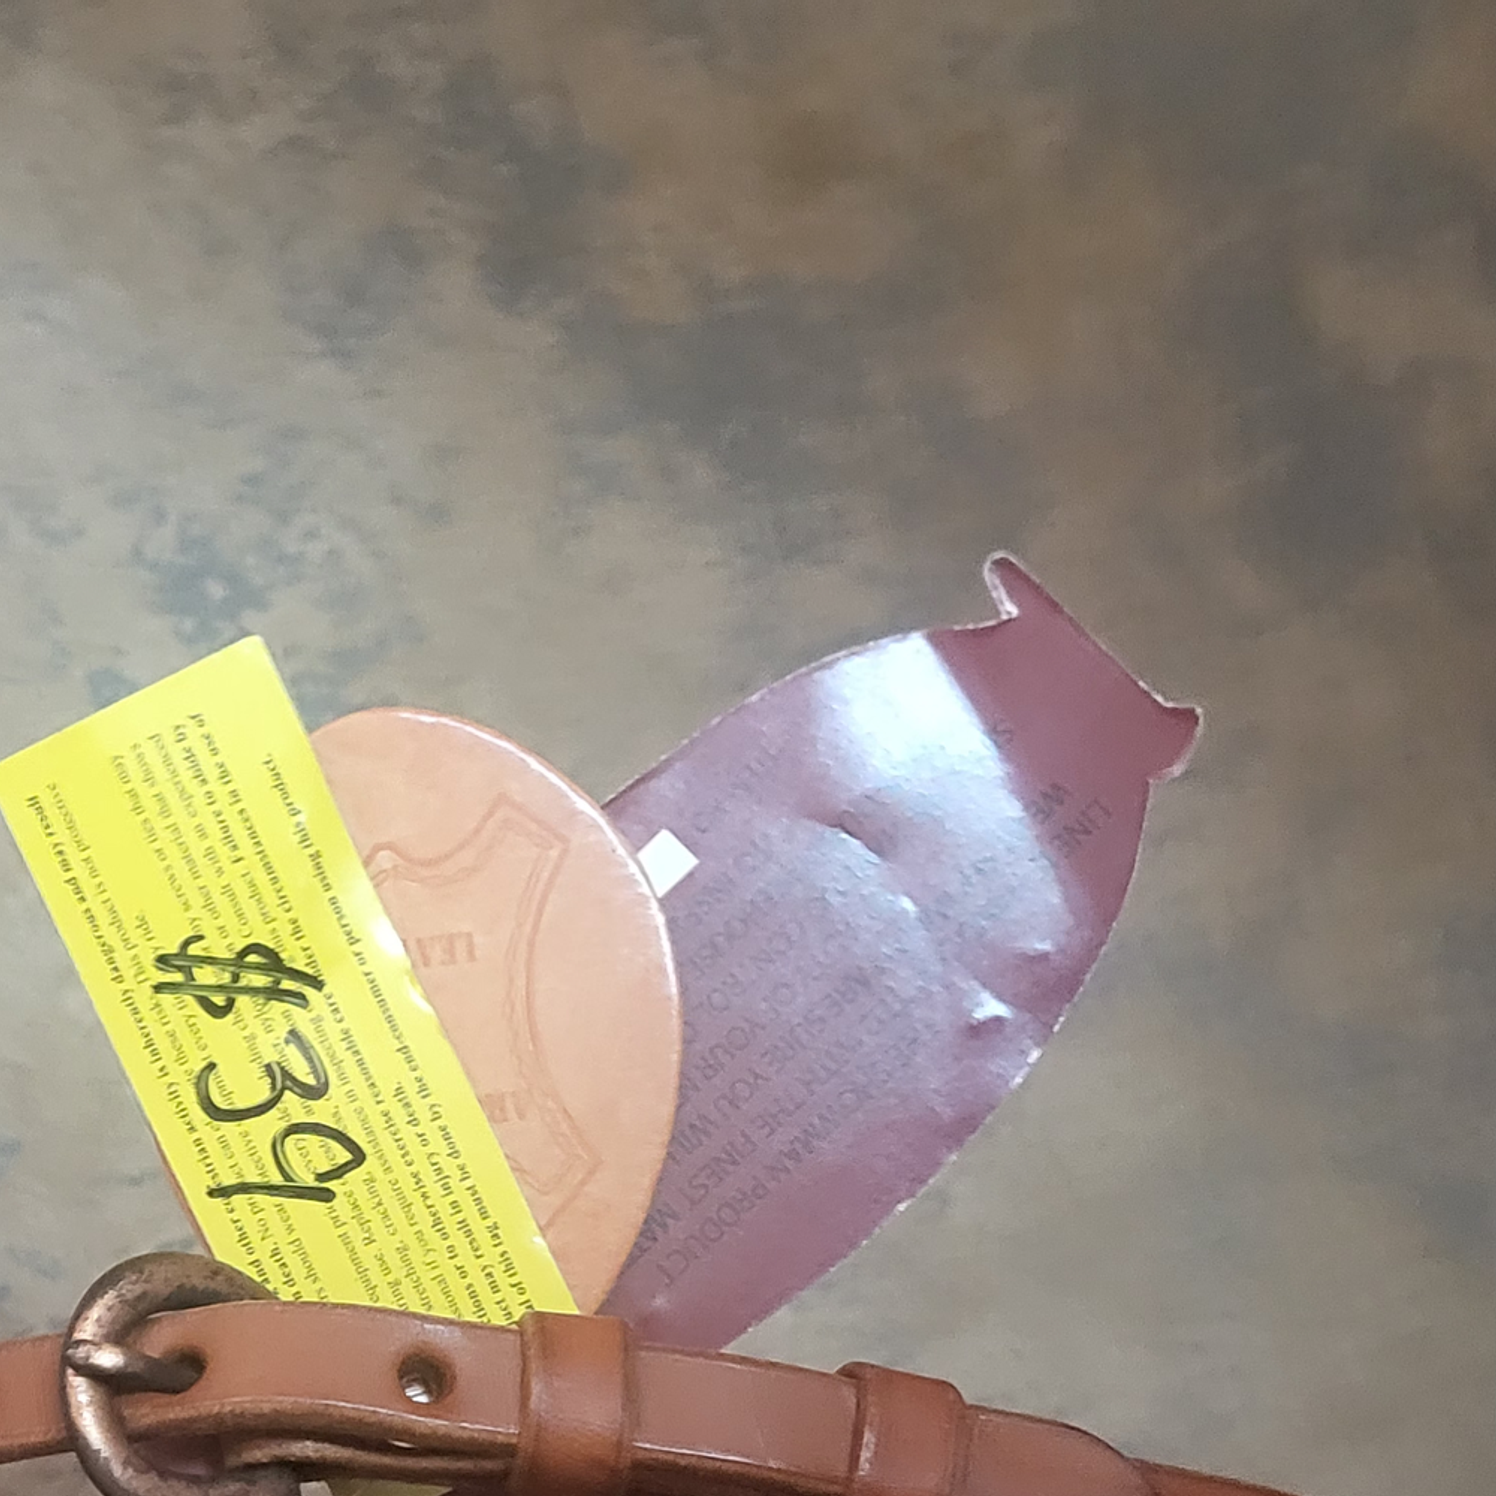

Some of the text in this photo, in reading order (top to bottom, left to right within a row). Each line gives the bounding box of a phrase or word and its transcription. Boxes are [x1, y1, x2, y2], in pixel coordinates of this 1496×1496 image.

[168, 721, 190, 744] by
[109, 751, 134, 785] may
[126, 741, 159, 790] shows
[146, 730, 201, 821] experienced
[177, 744, 209, 789] abide
[210, 759, 233, 787] the
[256, 750, 302, 820] product.
[123, 785, 147, 816] that
[148, 790, 173, 821] that
[199, 789, 217, 807] to
[223, 787, 242, 806] in
[24, 794, 56, 840] result
[193, 822, 209, 842] an
[207, 807, 245, 866] Failure
[288, 819, 314, 851] this
[48, 839, 74, 874] may
[80, 855, 100, 880] not
[153, 845, 169, 862] or
[163, 821, 202, 882] material
[199, 845, 226, 880] with
[232, 806, 294, 915] circumstances
[303, 848, 337, 894] using
[62, 875, 87, 906] and
[161, 863, 193, 914] screws
[192, 882, 222, 923] other
[97, 894, 138, 953] product
[216, 881, 255, 940] Consult
[284, 914, 307, 942] the
[325, 892, 362, 947] person
[77, 905, 128, 987] dangerous
[353, 949, 368, 966] or
[125, 953, 150, 985] This
[115, 985, 165, 1065] inherently
[323, 990, 346, 1024] care
[359, 968, 420, 1075] end-consumer
[161, 1028, 190, 1067] these
[181, 1008, 211, 1052] every
[305, 1012, 353, 1087] inspecting
[151, 1064, 170, 1080] is
[153, 932, 367, 1205] $39
[337, 1024, 385, 1107] reasonable
[341, 1087, 359, 1105] in
[388, 1079, 421, 1129] death.
[410, 1073, 432, 1100] the
[708, 1060, 772, 1123] YOU
[159, 1078, 200, 1137] activity
[423, 1100, 446, 1123] by
[215, 1133, 235, 1160] can
[349, 1104, 394, 1177] assistance
[377, 1107, 416, 1169] exercise
[415, 1128, 431, 1148] or
[433, 1122, 462, 1162] done
[422, 1148, 458, 1198] injury
[452, 1161, 472, 1183] be
[672, 1126, 759, 1214] FINEST
[273, 1200, 296, 1235] wear
[340, 1186, 380, 1246] Replace
[357, 1169, 402, 1238] cracking,
[385, 1174, 422, 1228] require
[405, 1167, 451, 1243] otherwise
[444, 1198, 463, 1217] in
[463, 1182, 491, 1222] must
[228, 1217, 257, 1258] other
[252, 1216, 273, 1242] No
[413, 1227, 436, 1256] you
[453, 1216, 485, 1262] result
[482, 1220, 506, 1248] tag
[650, 1170, 772, 1292] PRODUCT
[264, 1241, 297, 1290] death.
[286, 1236, 320, 1286] should
[336, 1228, 384, 1305] equipment
[442, 1243, 460, 1261] to
[453, 1260, 469, 1280] or
[494, 1249, 519, 1280] this
[247, 1257, 271, 1288] and
[479, 1260, 504, 1295] may
[508, 1278, 528, 1299] of
